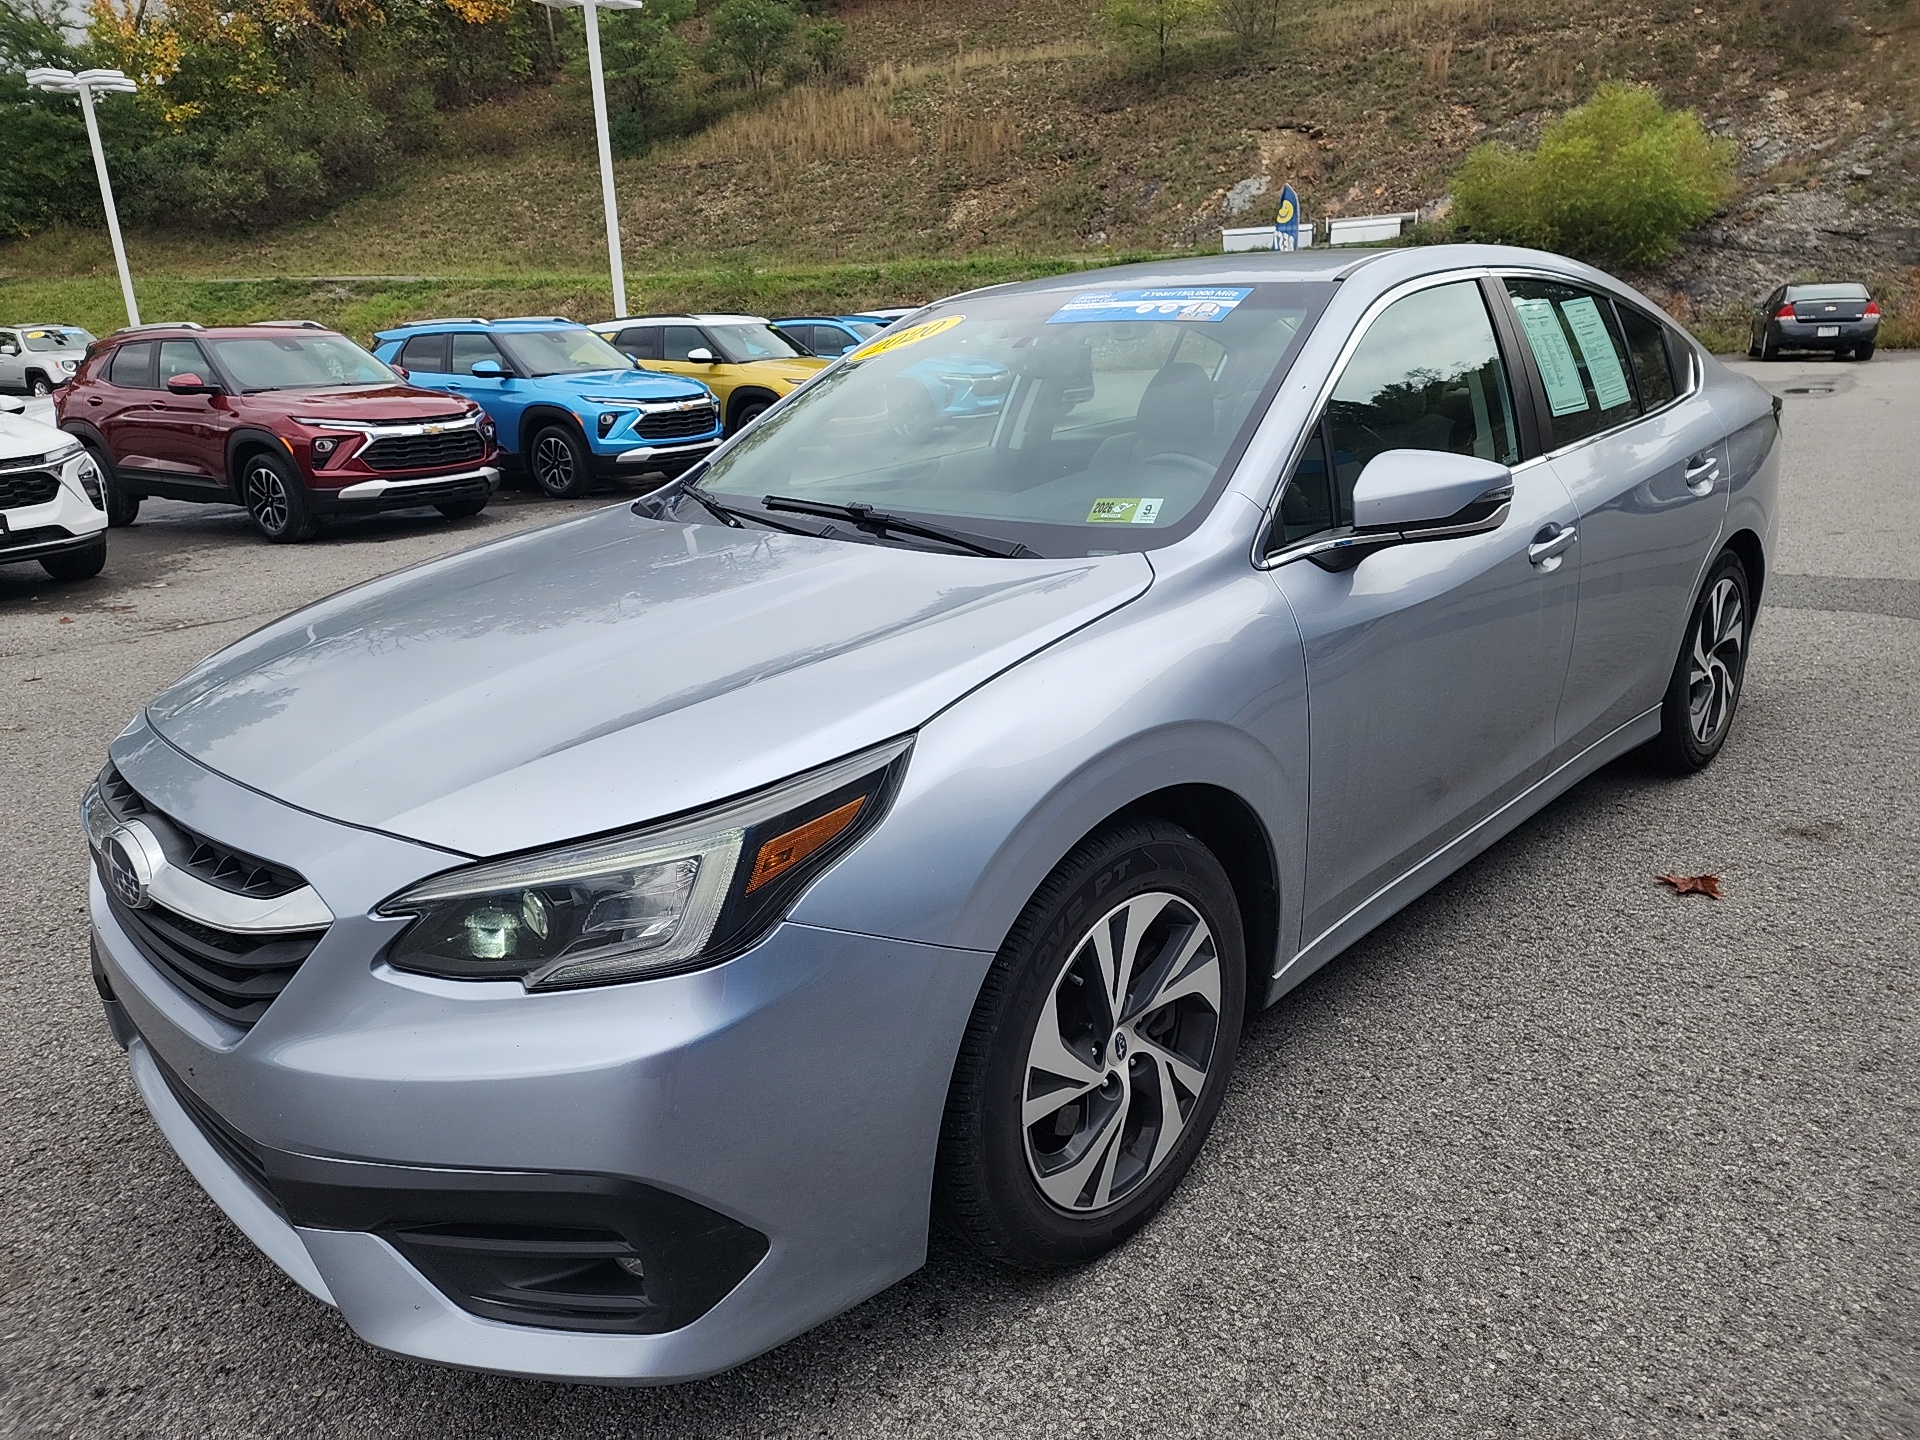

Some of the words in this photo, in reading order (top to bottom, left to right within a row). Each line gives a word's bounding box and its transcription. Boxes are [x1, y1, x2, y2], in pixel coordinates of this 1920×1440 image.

[857, 320, 948, 358] 2020
[1093, 502, 1114, 514] 2026
[1142, 504, 1153, 516] 9
[1094, 858, 1131, 897] PT
